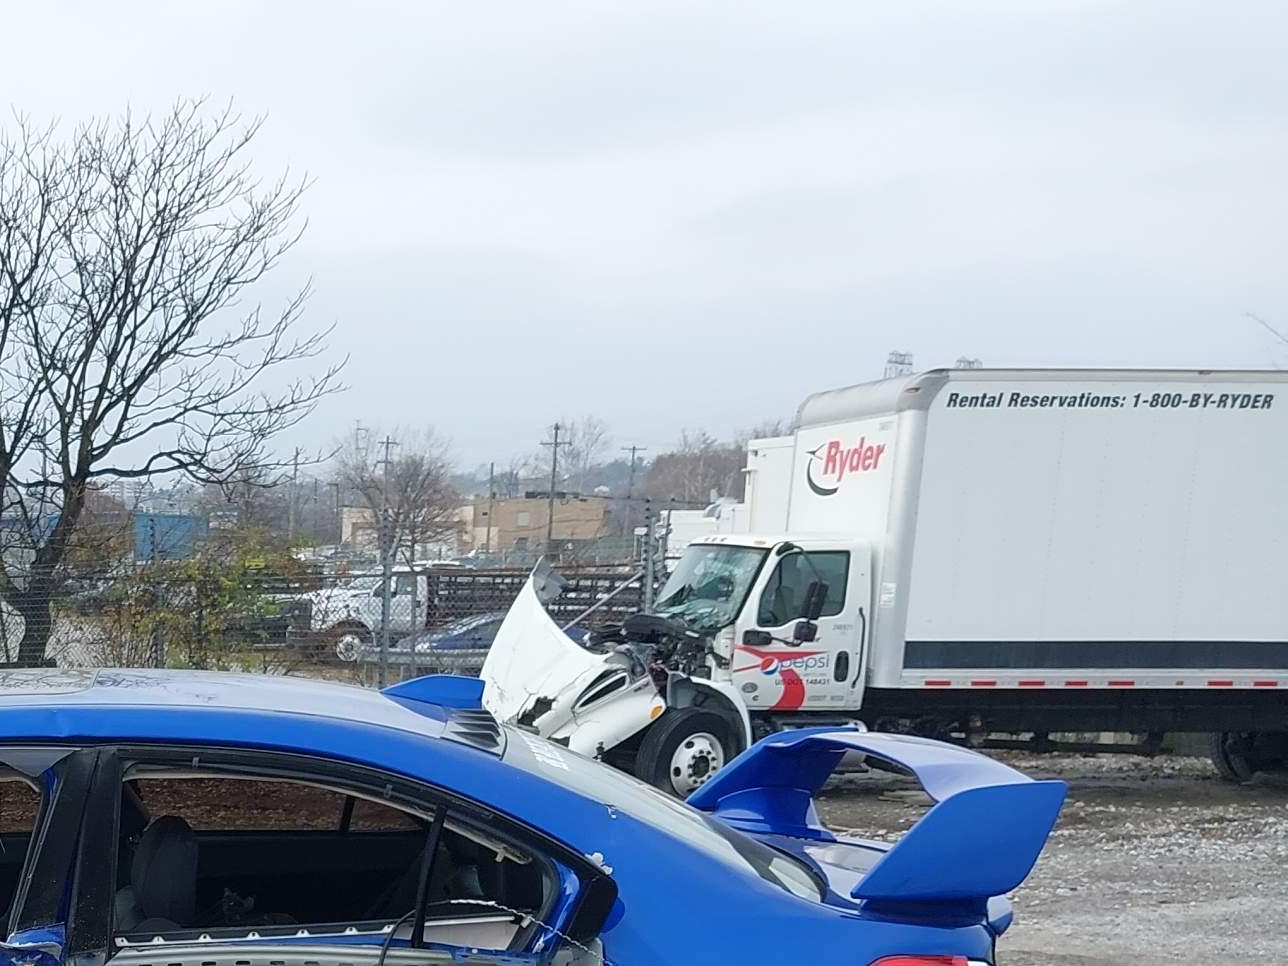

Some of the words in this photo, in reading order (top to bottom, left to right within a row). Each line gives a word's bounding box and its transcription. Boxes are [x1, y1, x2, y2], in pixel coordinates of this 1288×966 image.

[946, 392, 1004, 408] Rental
[1007, 392, 1127, 408] Reservations:
[1132, 392, 1275, 409] 1-800-BY-RYDER
[823, 436, 886, 482] Ryder
[779, 654, 830, 671] pepsi
